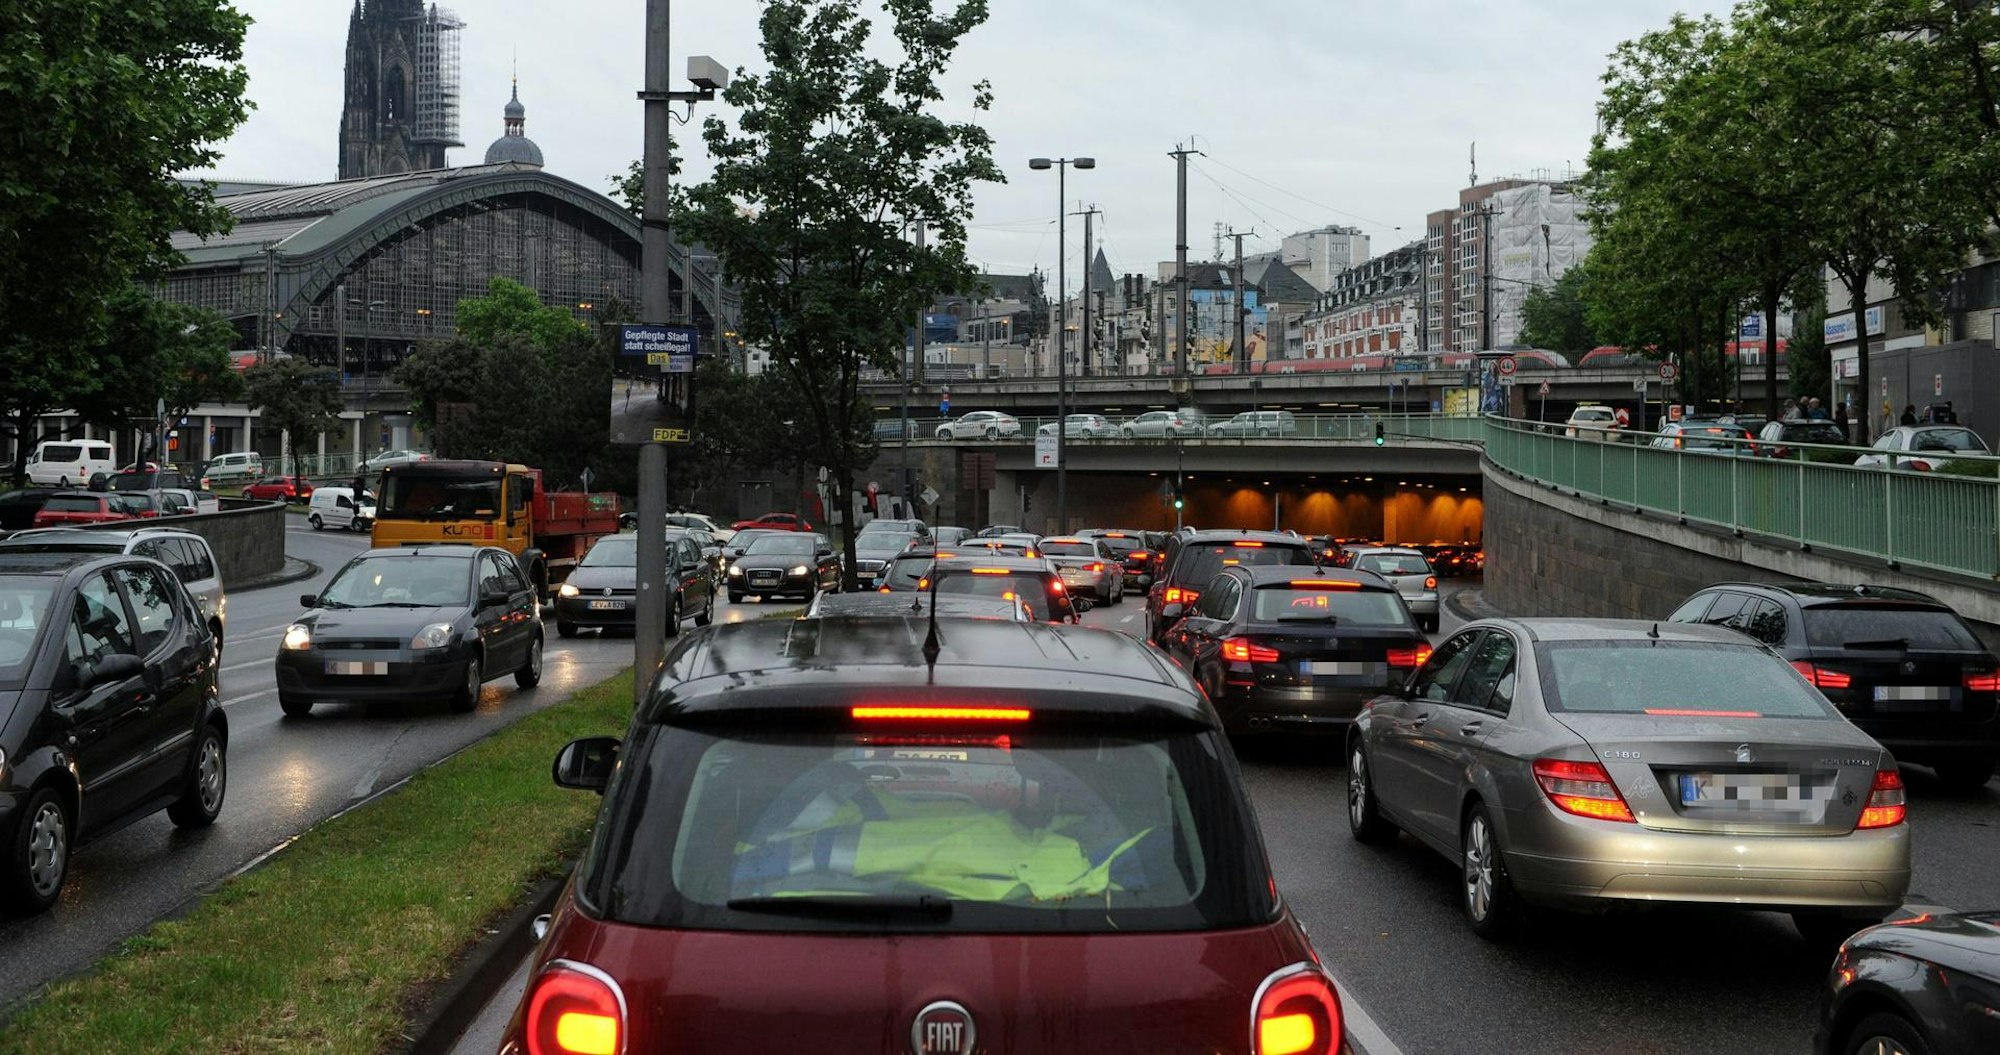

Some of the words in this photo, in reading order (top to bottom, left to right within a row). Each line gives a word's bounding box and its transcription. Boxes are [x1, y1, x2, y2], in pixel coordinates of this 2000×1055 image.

[625, 330, 665, 341] Gepflegte
[667, 332, 688, 342] Stadt
[625, 341, 643, 350] statt
[645, 342, 691, 353] scheißegal!
[650, 354, 666, 363] Das
[655, 430, 676, 439] FDP
[1615, 751, 1641, 759] 180
[927, 1022, 963, 1052] FIAT
